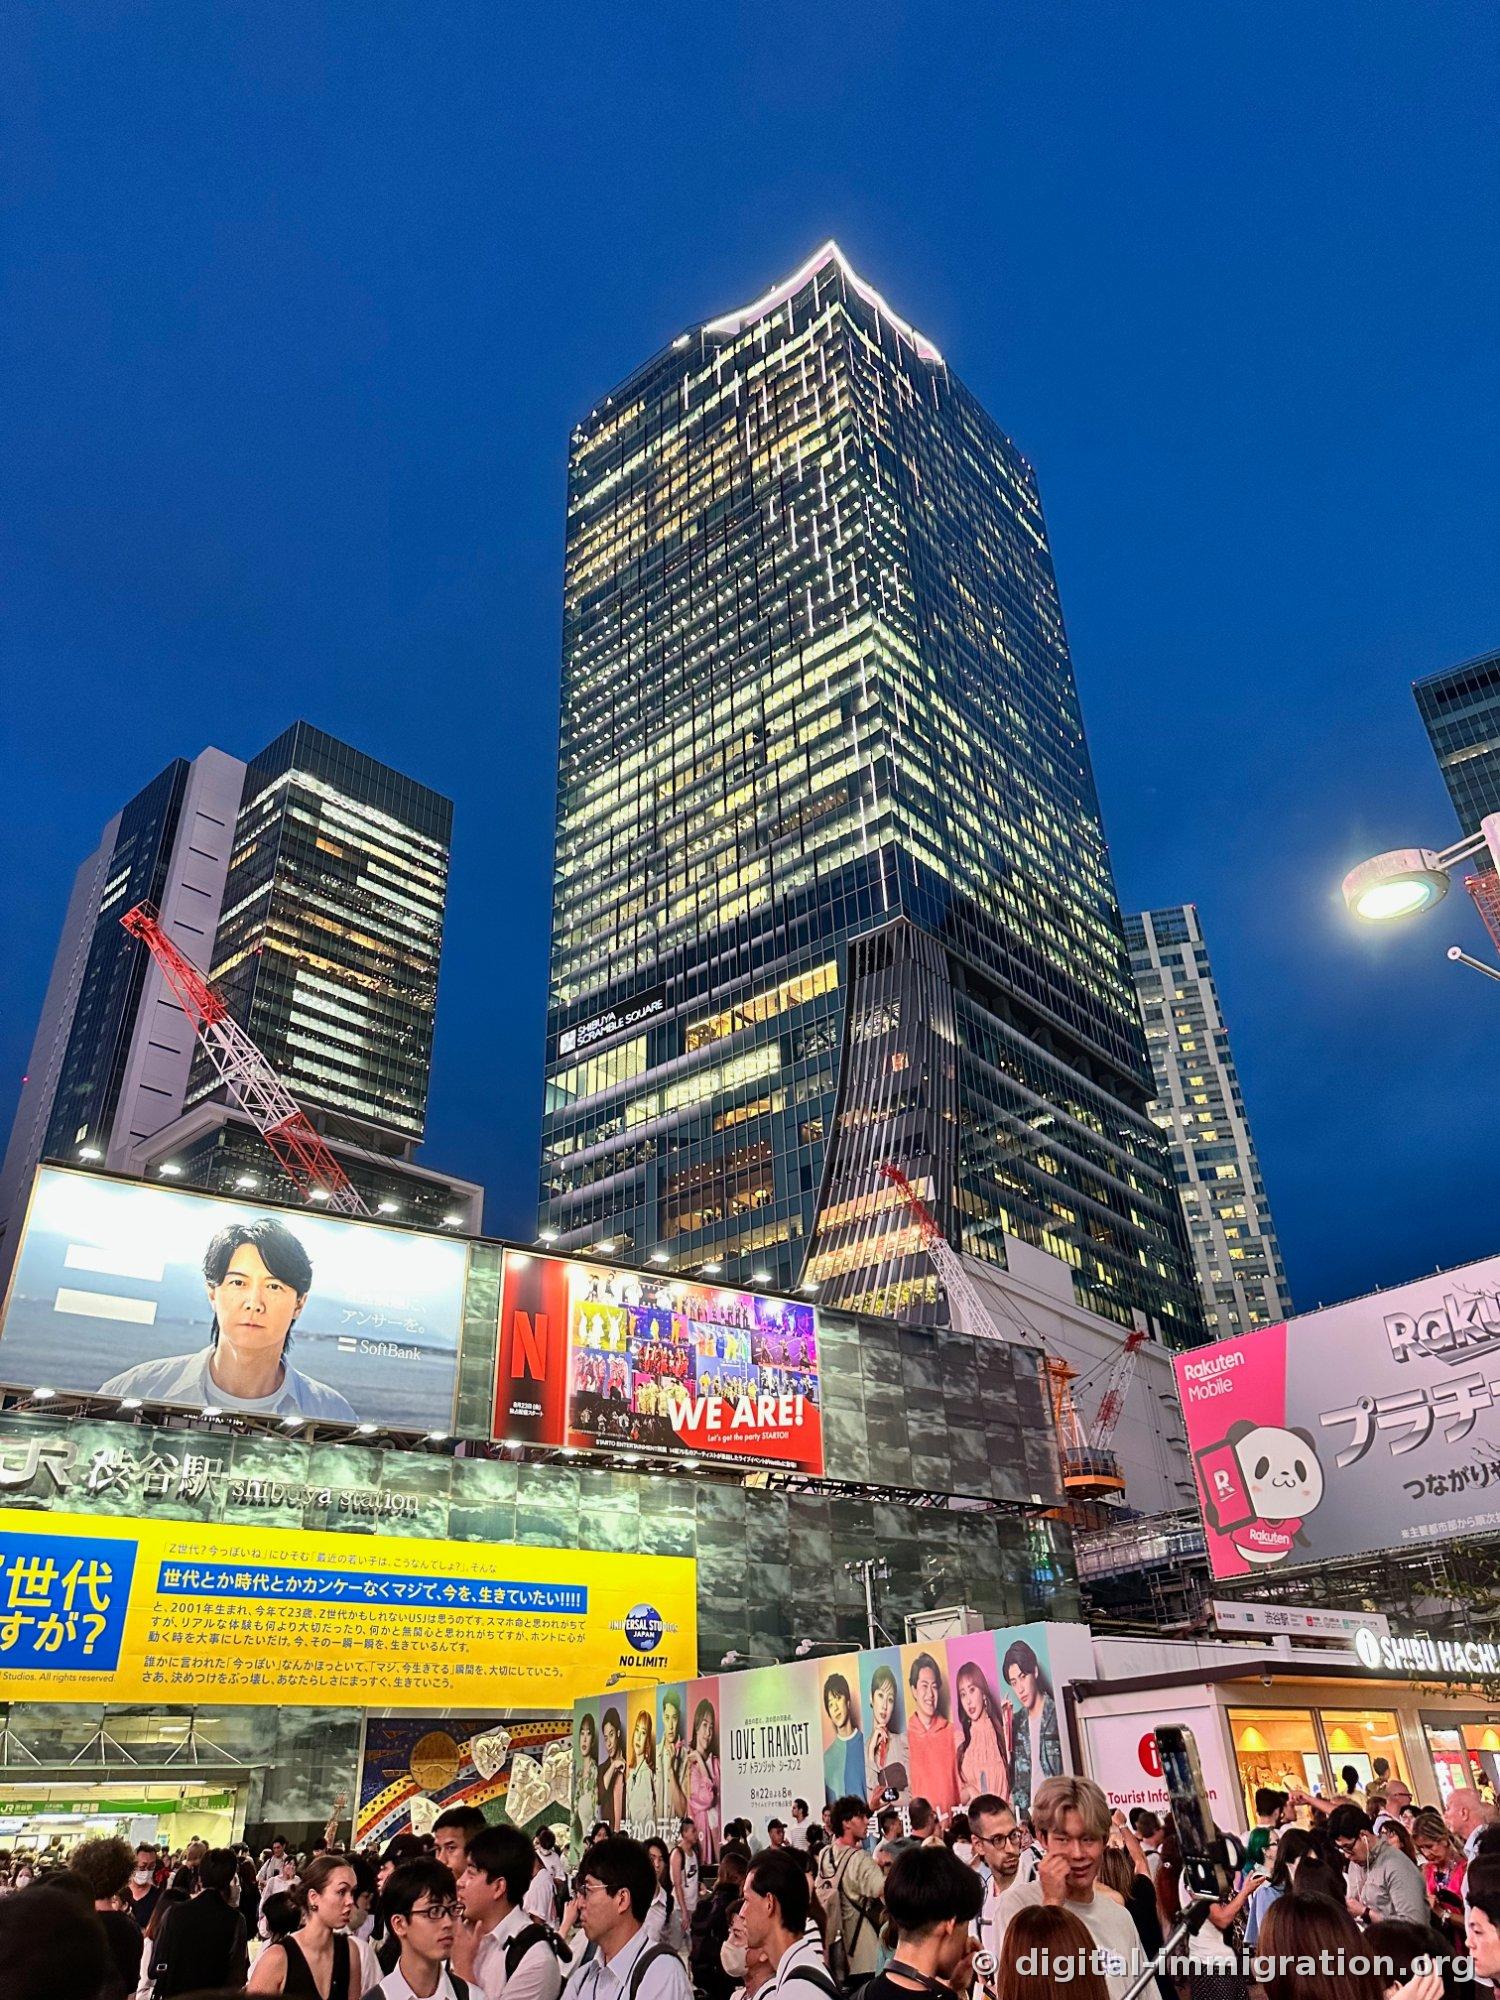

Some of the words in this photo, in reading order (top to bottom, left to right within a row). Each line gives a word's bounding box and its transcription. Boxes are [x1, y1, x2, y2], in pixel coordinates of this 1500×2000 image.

[577, 1017, 625, 1047] SCRAMBLE
[625, 999, 664, 1025] SQUARE
[578, 1012, 616, 1036] SHIBUYA
[341, 1309, 425, 1334] アンサーを。
[359, 1339, 421, 1360] SoftBank
[511, 1310, 548, 1381] N
[1184, 1351, 1245, 1382] Rakuten
[1188, 1377, 1234, 1402] Mobile
[666, 1396, 722, 1432] WE
[730, 1393, 805, 1428] ARE!
[1319, 1372, 1500, 1469] プラチ
[708, 1433, 721, 1442] Let's
[722, 1434, 733, 1443] get
[734, 1432, 743, 1440] the
[744, 1433, 761, 1442] party
[0, 1438, 79, 1488] JR
[87, 1446, 224, 1503] 渋谷駅
[231, 1478, 333, 1505] shibuya
[339, 1486, 420, 1512] station
[1249, 1528, 1290, 1545] Rakuten
[0, 1553, 113, 1612] 世代
[608, 1619, 648, 1630] UNIVERSAL
[620, 1656, 635, 1667] NO
[635, 1656, 668, 1668] LIMIT!
[3, 1671, 37, 1681] Studios.
[39, 1672, 51, 1681] All
[53, 1673, 77, 1683] rights
[78, 1674, 116, 1683] reserved.
[730, 1727, 756, 1760] LOVE
[738, 1761, 747, 1774] ラブ
[750, 1760, 776, 1774] トランジット
[779, 1759, 801, 1772] シーズン2
[1107, 1789, 1145, 1804] Tourist
